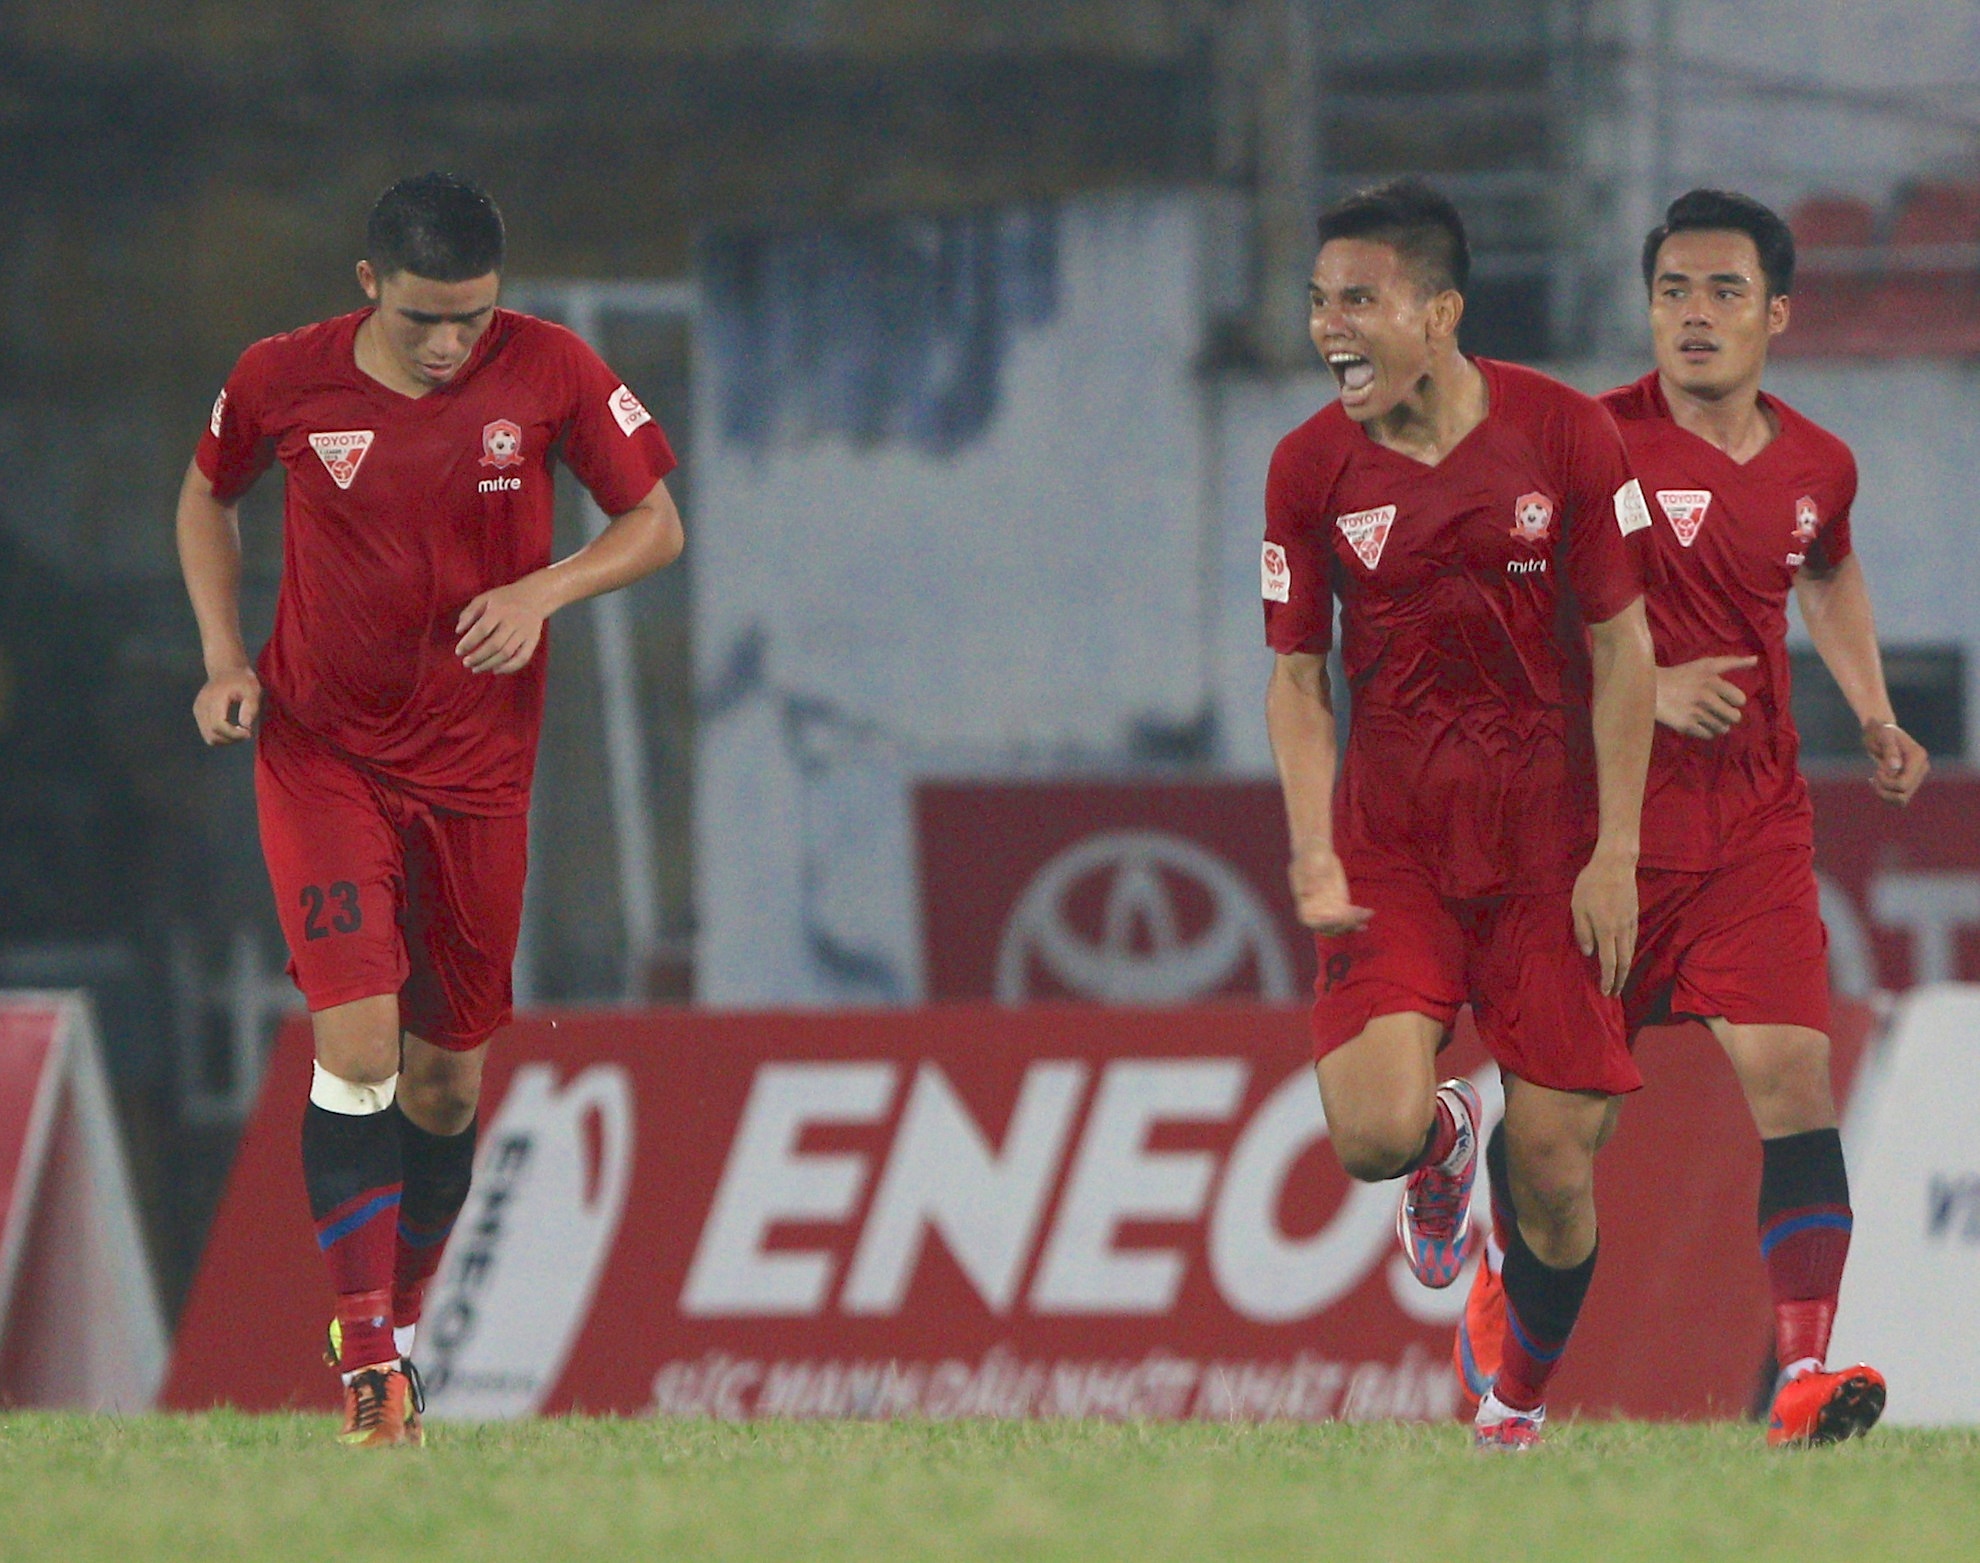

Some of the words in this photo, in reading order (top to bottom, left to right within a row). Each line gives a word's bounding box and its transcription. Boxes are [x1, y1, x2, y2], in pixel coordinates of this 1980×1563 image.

[314, 434, 367, 447] TOYOTA
[478, 475, 522, 493] mitre
[1662, 494, 1705, 504] TOYOTA
[1342, 511, 1390, 528] TOYOTA
[300, 881, 362, 941] 23
